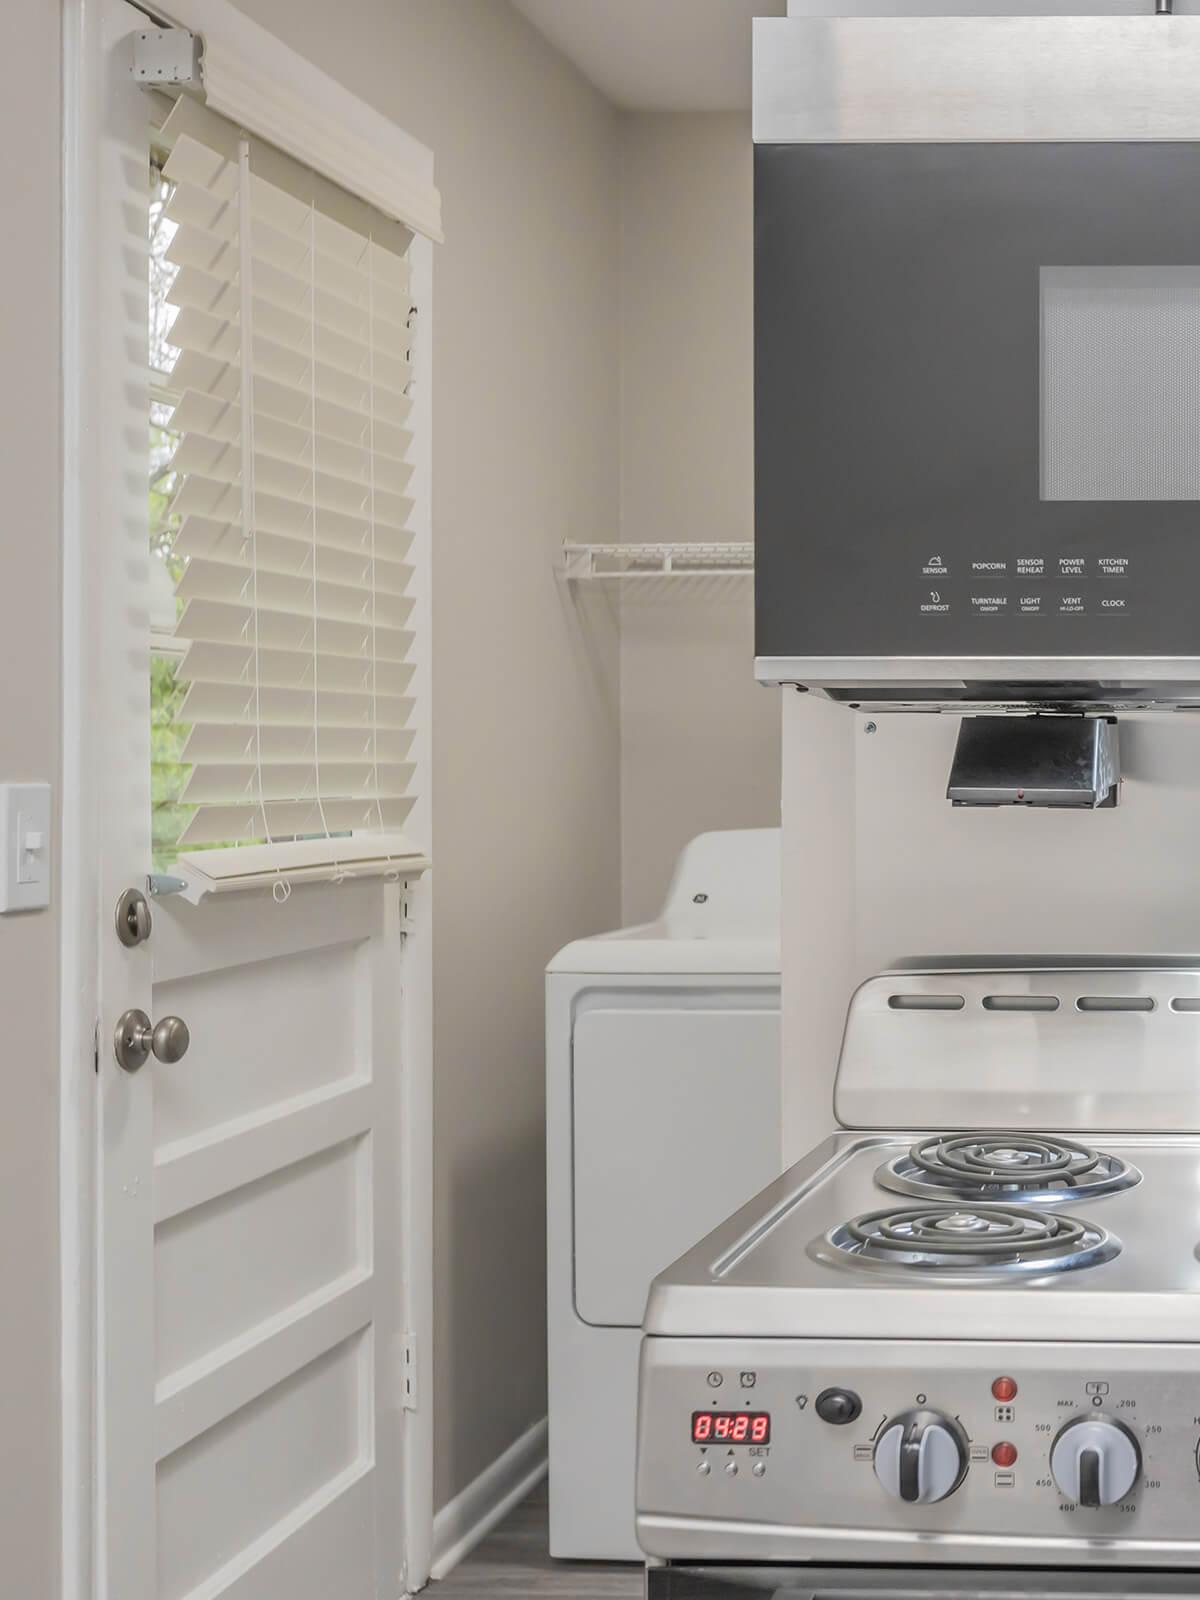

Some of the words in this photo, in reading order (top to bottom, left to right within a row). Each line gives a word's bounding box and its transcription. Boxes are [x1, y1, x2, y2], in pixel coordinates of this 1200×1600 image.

[972, 562, 1006, 570] POPCORN
[1017, 558, 1044, 566] SENSOR
[1059, 558, 1085, 566] POWER
[1099, 558, 1129, 566] KITCHEN
[1017, 566, 1044, 574] REHEAT
[1061, 566, 1082, 574] LEVEL
[1103, 566, 1124, 574] TIMER
[971, 597, 1007, 605] TURNTABLE
[1020, 597, 1041, 605] LIGHT
[1062, 597, 1081, 605] VENT
[1101, 599, 1125, 607] CLOCK
[1120, 1400, 1136, 1408] 200
[694, 1415, 768, 1440] 04:29
[1035, 1424, 1051, 1432] 500
[1146, 1425, 1162, 1433] 250
[749, 1447, 770, 1457] SET
[1036, 1479, 1052, 1487] 450
[1059, 1503, 1075, 1512] 400
